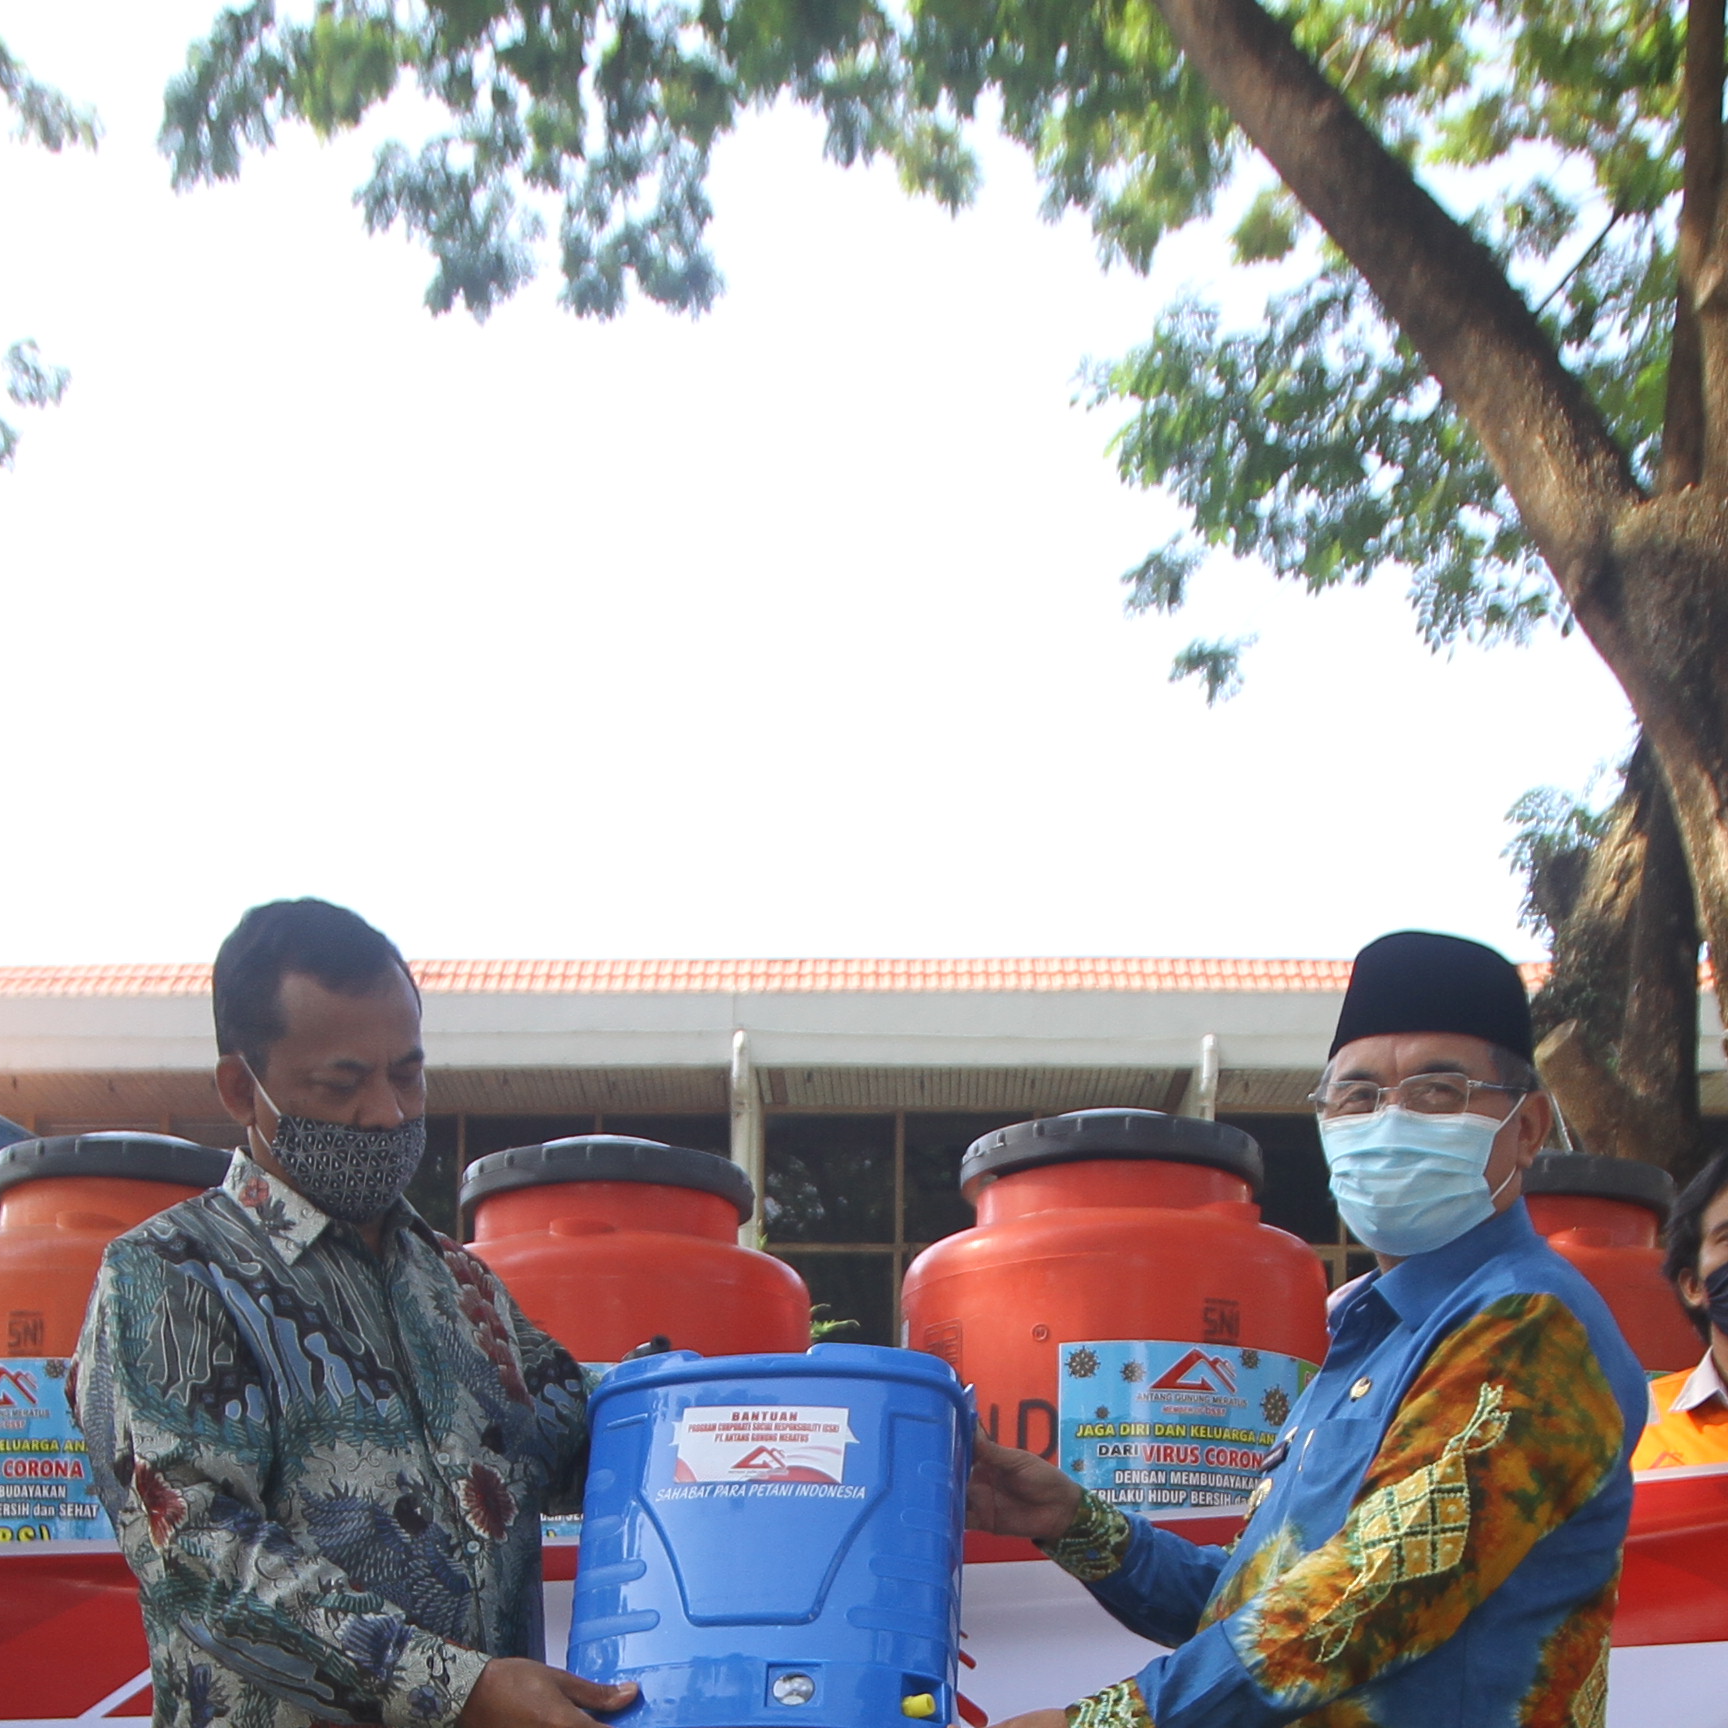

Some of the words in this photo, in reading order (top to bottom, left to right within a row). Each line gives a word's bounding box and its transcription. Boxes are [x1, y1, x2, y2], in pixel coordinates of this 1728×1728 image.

[1137, 1393, 1174, 1402] ANTANG
[1175, 1393, 1212, 1403] GUNUNG
[1212, 1396, 1248, 1407] MERATUS
[731, 1411, 798, 1422] BANTUAN
[725, 1434, 750, 1443] ANTANG
[751, 1434, 778, 1442] GUNUNG
[779, 1434, 809, 1443] MERATUS
[1076, 1424, 1115, 1438] JAGA
[1119, 1423, 1150, 1437] DIRI
[1154, 1424, 1186, 1438] DAN
[1190, 1424, 1256, 1445] KELUARGA
[63, 1439, 88, 1453] AN
[1097, 1443, 1139, 1457] DARI
[1141, 1444, 1200, 1465] VIRUS
[1203, 1446, 1264, 1470] CORON
[2, 1457, 85, 1479] CORONA
[1114, 1470, 1167, 1486] DENGAN
[656, 1484, 711, 1502] SAHABAT
[713, 1485, 746, 1498] PARA
[748, 1483, 796, 1498] PETANI
[797, 1484, 866, 1499] INDONESIA
[1148, 1489, 1187, 1505] HIDUP
[1190, 1490, 1232, 1507] BERSIH
[32, 1503, 56, 1516] dan
[58, 1504, 99, 1518] SEHAT
